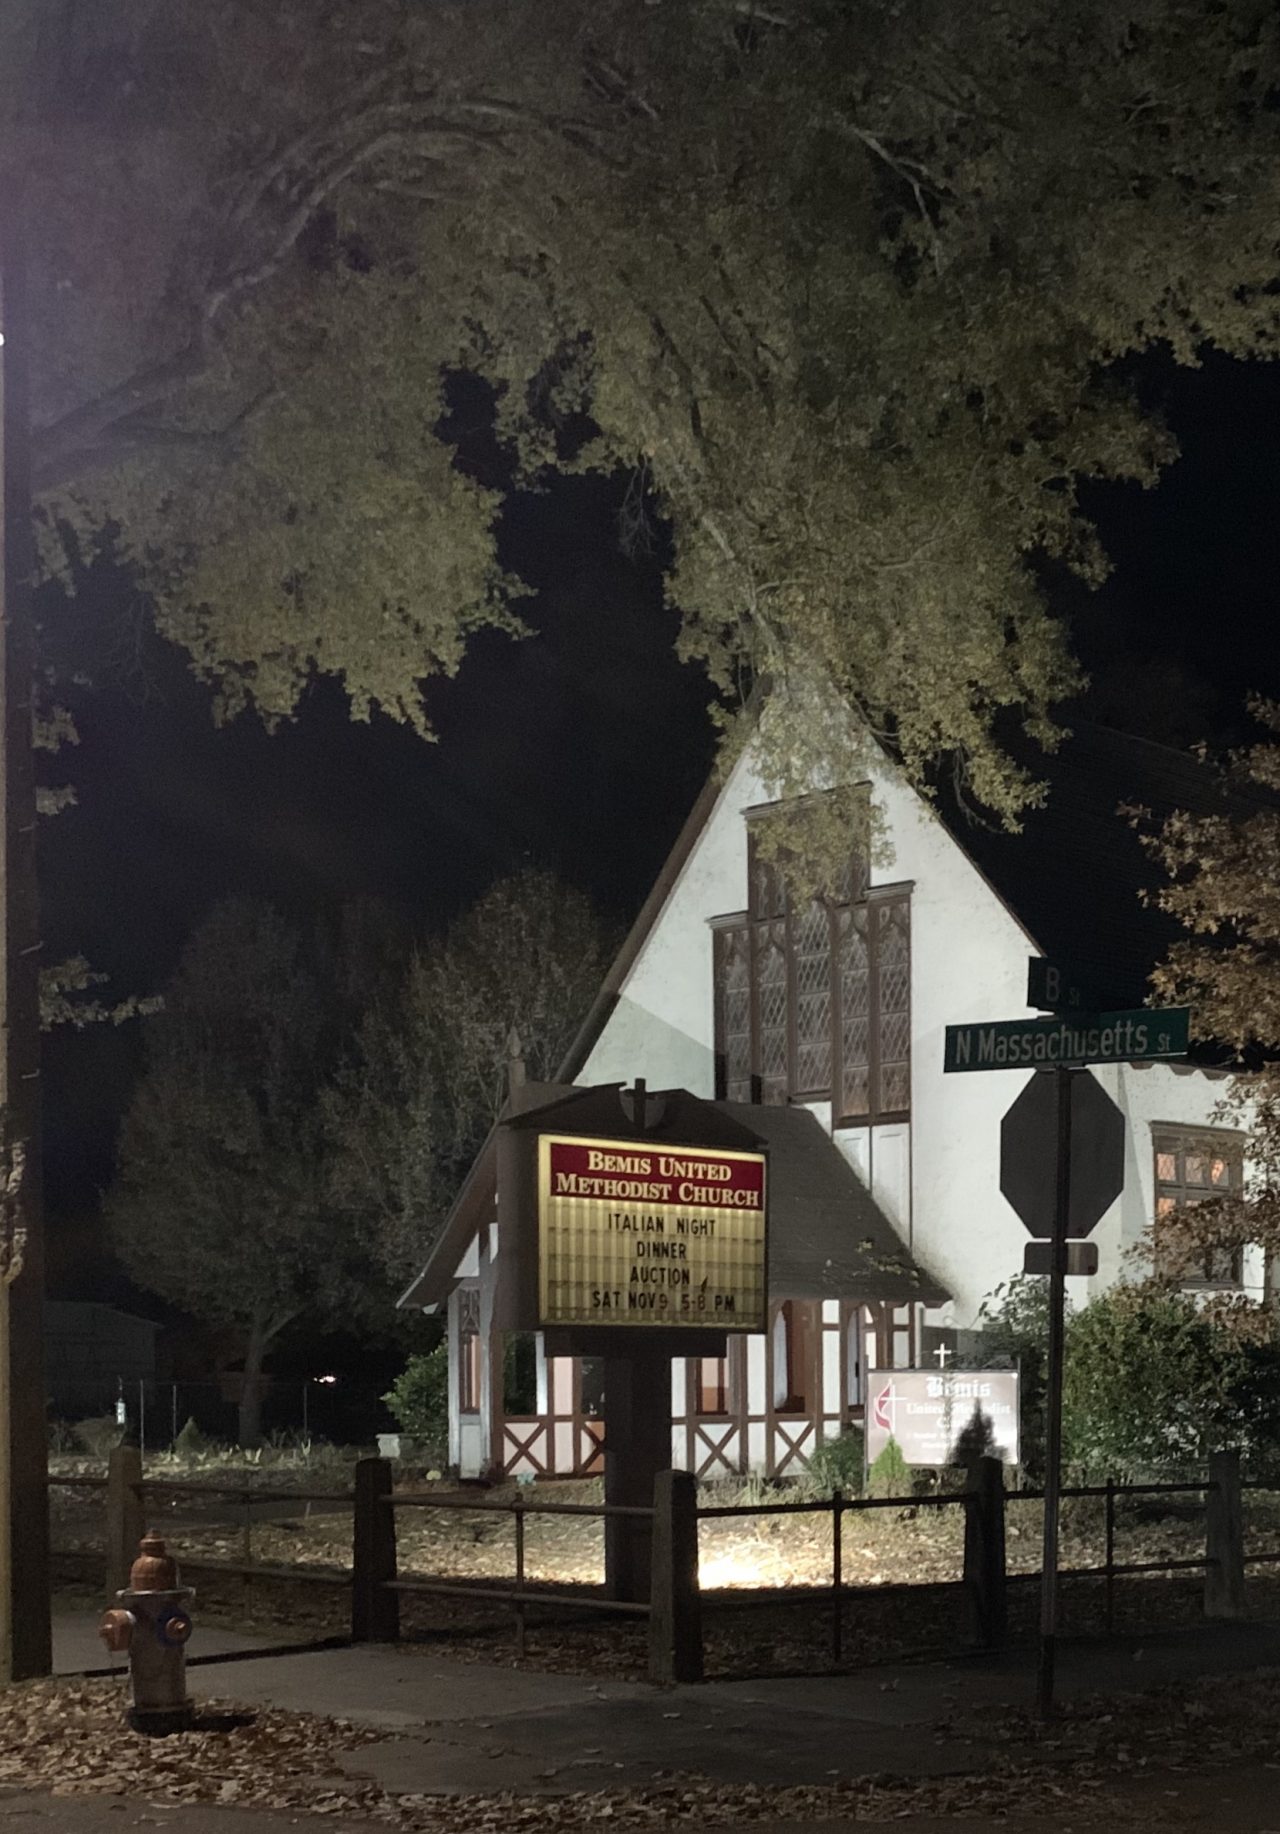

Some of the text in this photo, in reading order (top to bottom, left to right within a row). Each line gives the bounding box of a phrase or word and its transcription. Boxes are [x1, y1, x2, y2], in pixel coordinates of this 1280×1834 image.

[1046, 967, 1060, 1002] B
[956, 1019, 1170, 1064] N Massachusetts St
[588, 1150, 732, 1181] BEMIS UNITED
[556, 1172, 758, 1206] METHODIST CHURCH
[609, 1213, 715, 1235] ITALIAN NIGHT
[637, 1242, 687, 1260] DINNER
[630, 1267, 690, 1285] AUCTION
[593, 1291, 620, 1307] SAT
[681, 1295, 706, 1310] 5-8
[715, 1296, 735, 1311] PM
[926, 1376, 991, 1397] Bemis
